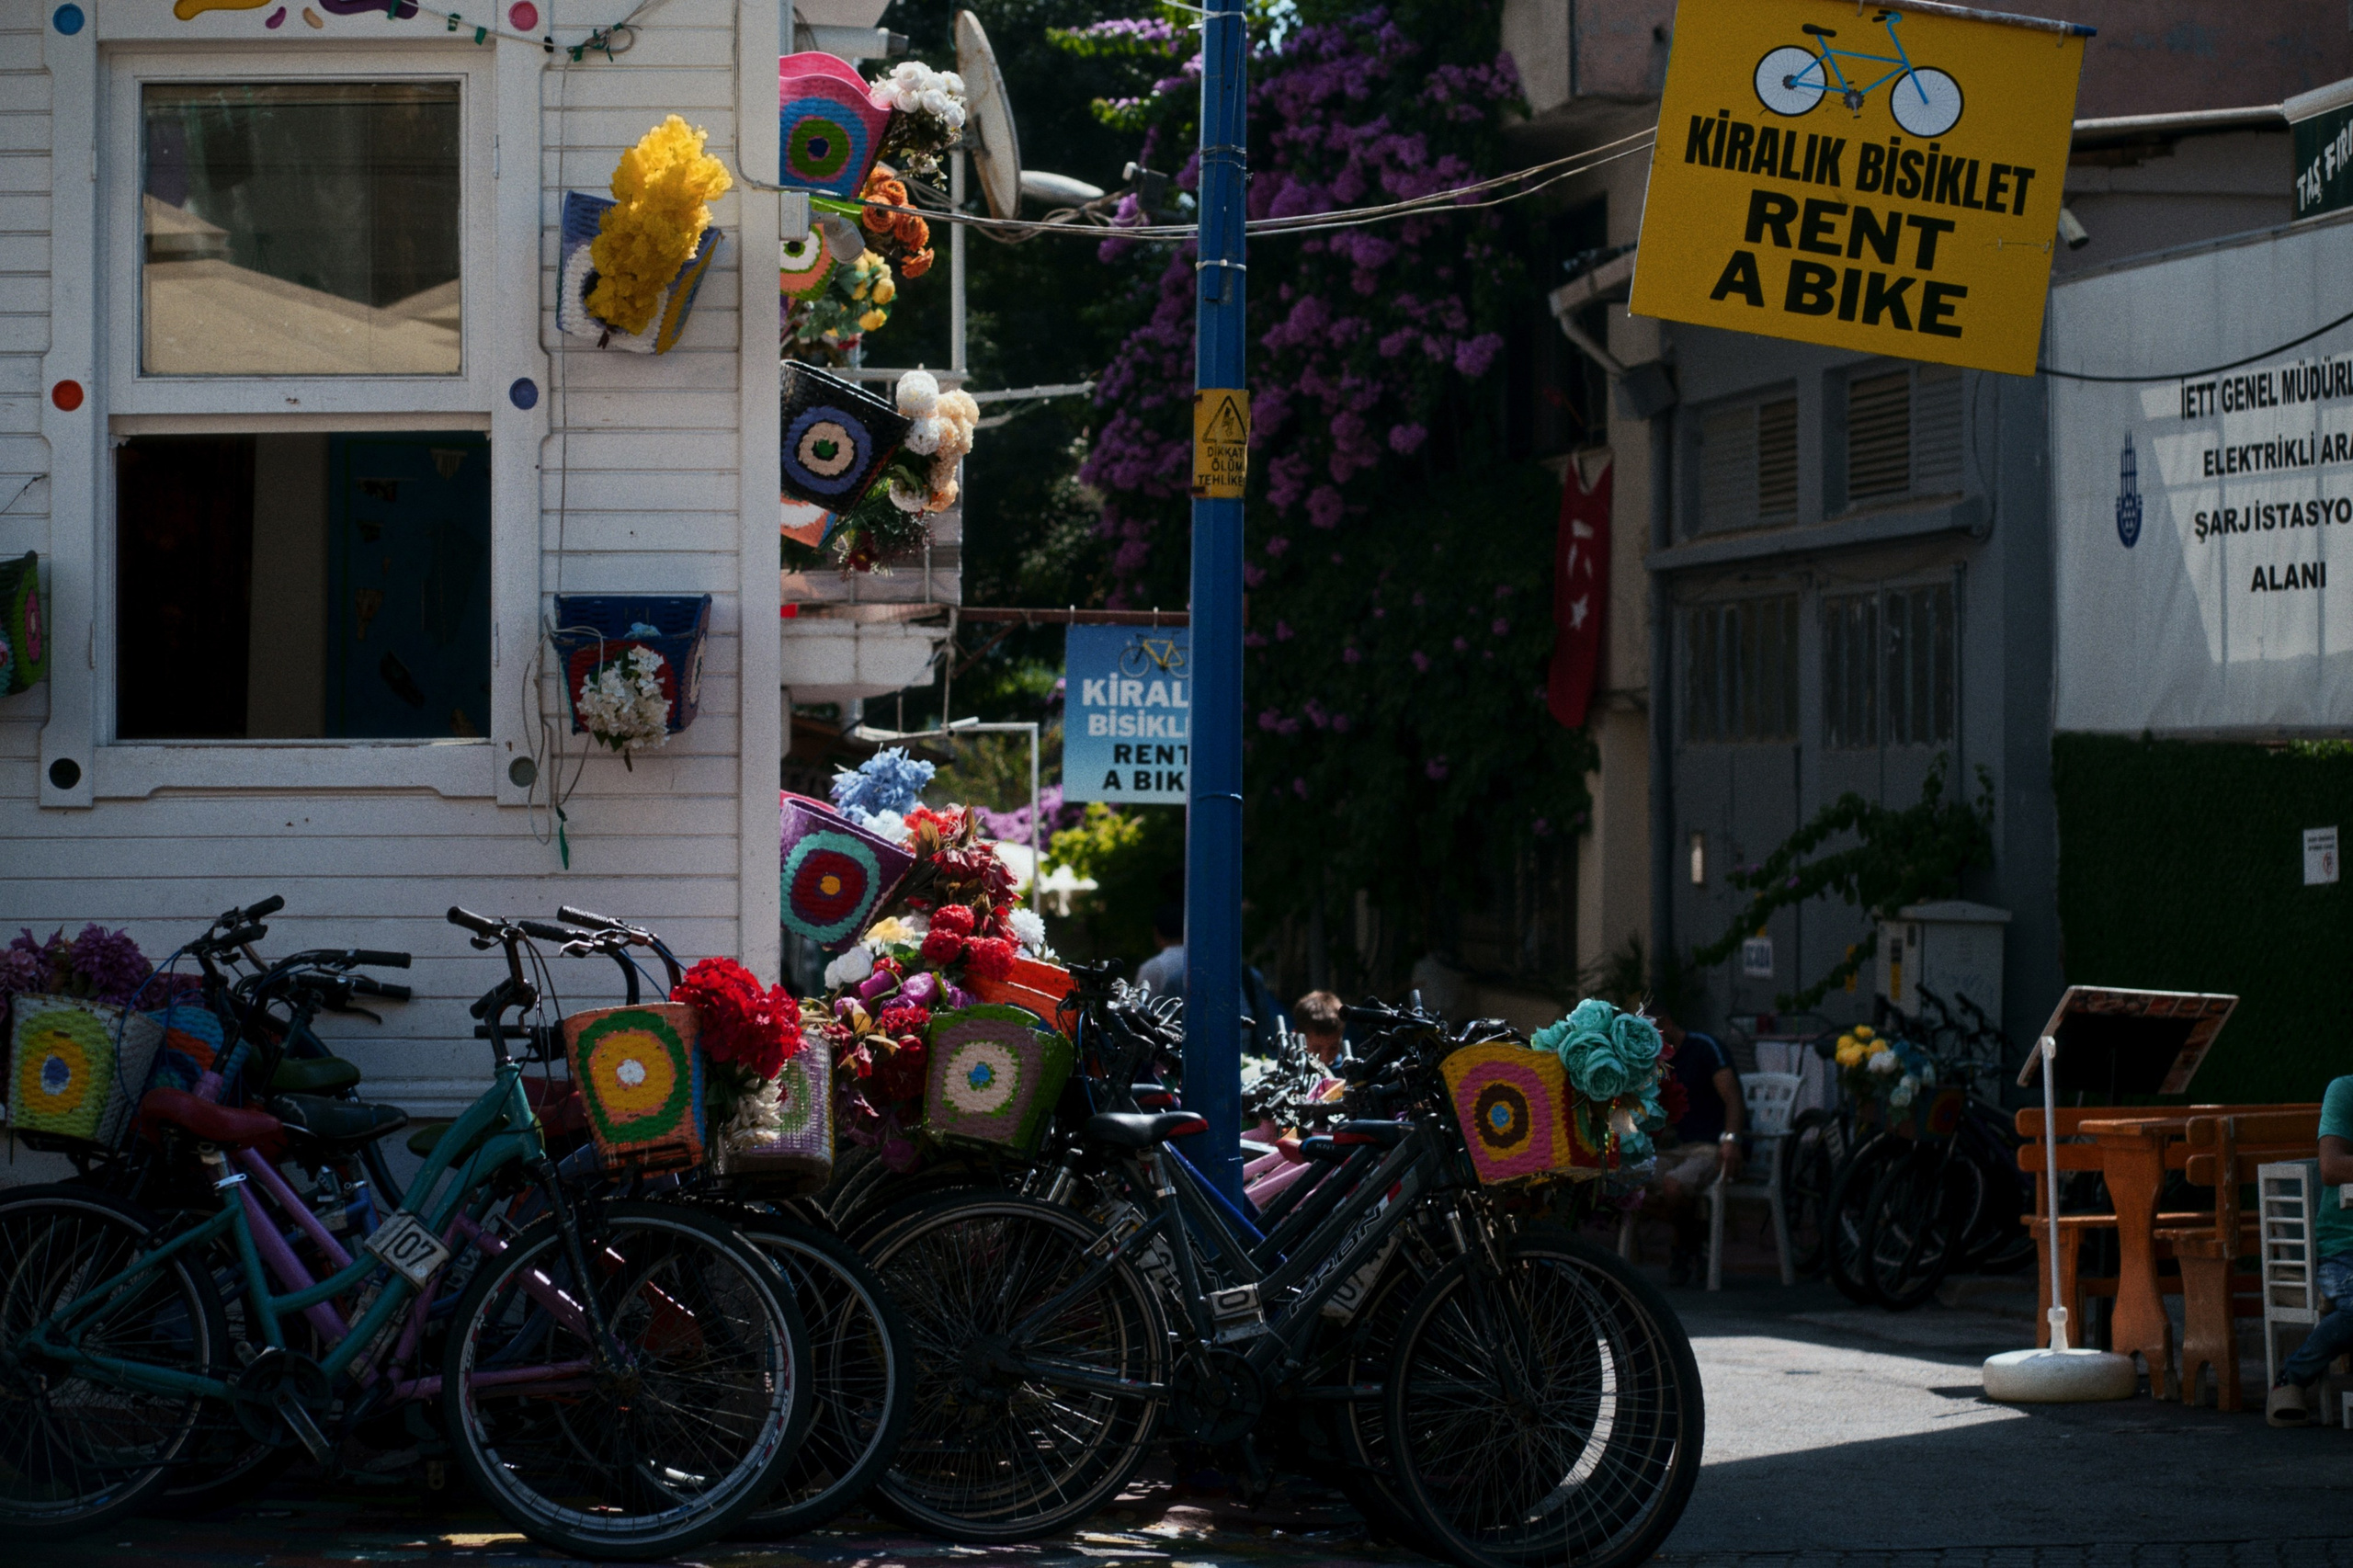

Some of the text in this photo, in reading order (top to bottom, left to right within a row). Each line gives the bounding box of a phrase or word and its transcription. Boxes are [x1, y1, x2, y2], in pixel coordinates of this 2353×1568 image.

[1684, 108, 2036, 216] KİRALIK BİSİKLET
[1745, 188, 1956, 270] RENT
[1710, 249, 1969, 338] A BIKE
[2221, 371, 2279, 413] GENEL
[1207, 445, 1244, 459] DİKKAT
[2203, 430, 2315, 477] ELEKTRİKLİ
[2194, 507, 2250, 544] ŞARJ
[2250, 562, 2327, 593] ALANI
[1087, 709, 1188, 738] BİSİKL
[1103, 770, 1122, 790] A
[392, 1231, 438, 1268] 07
